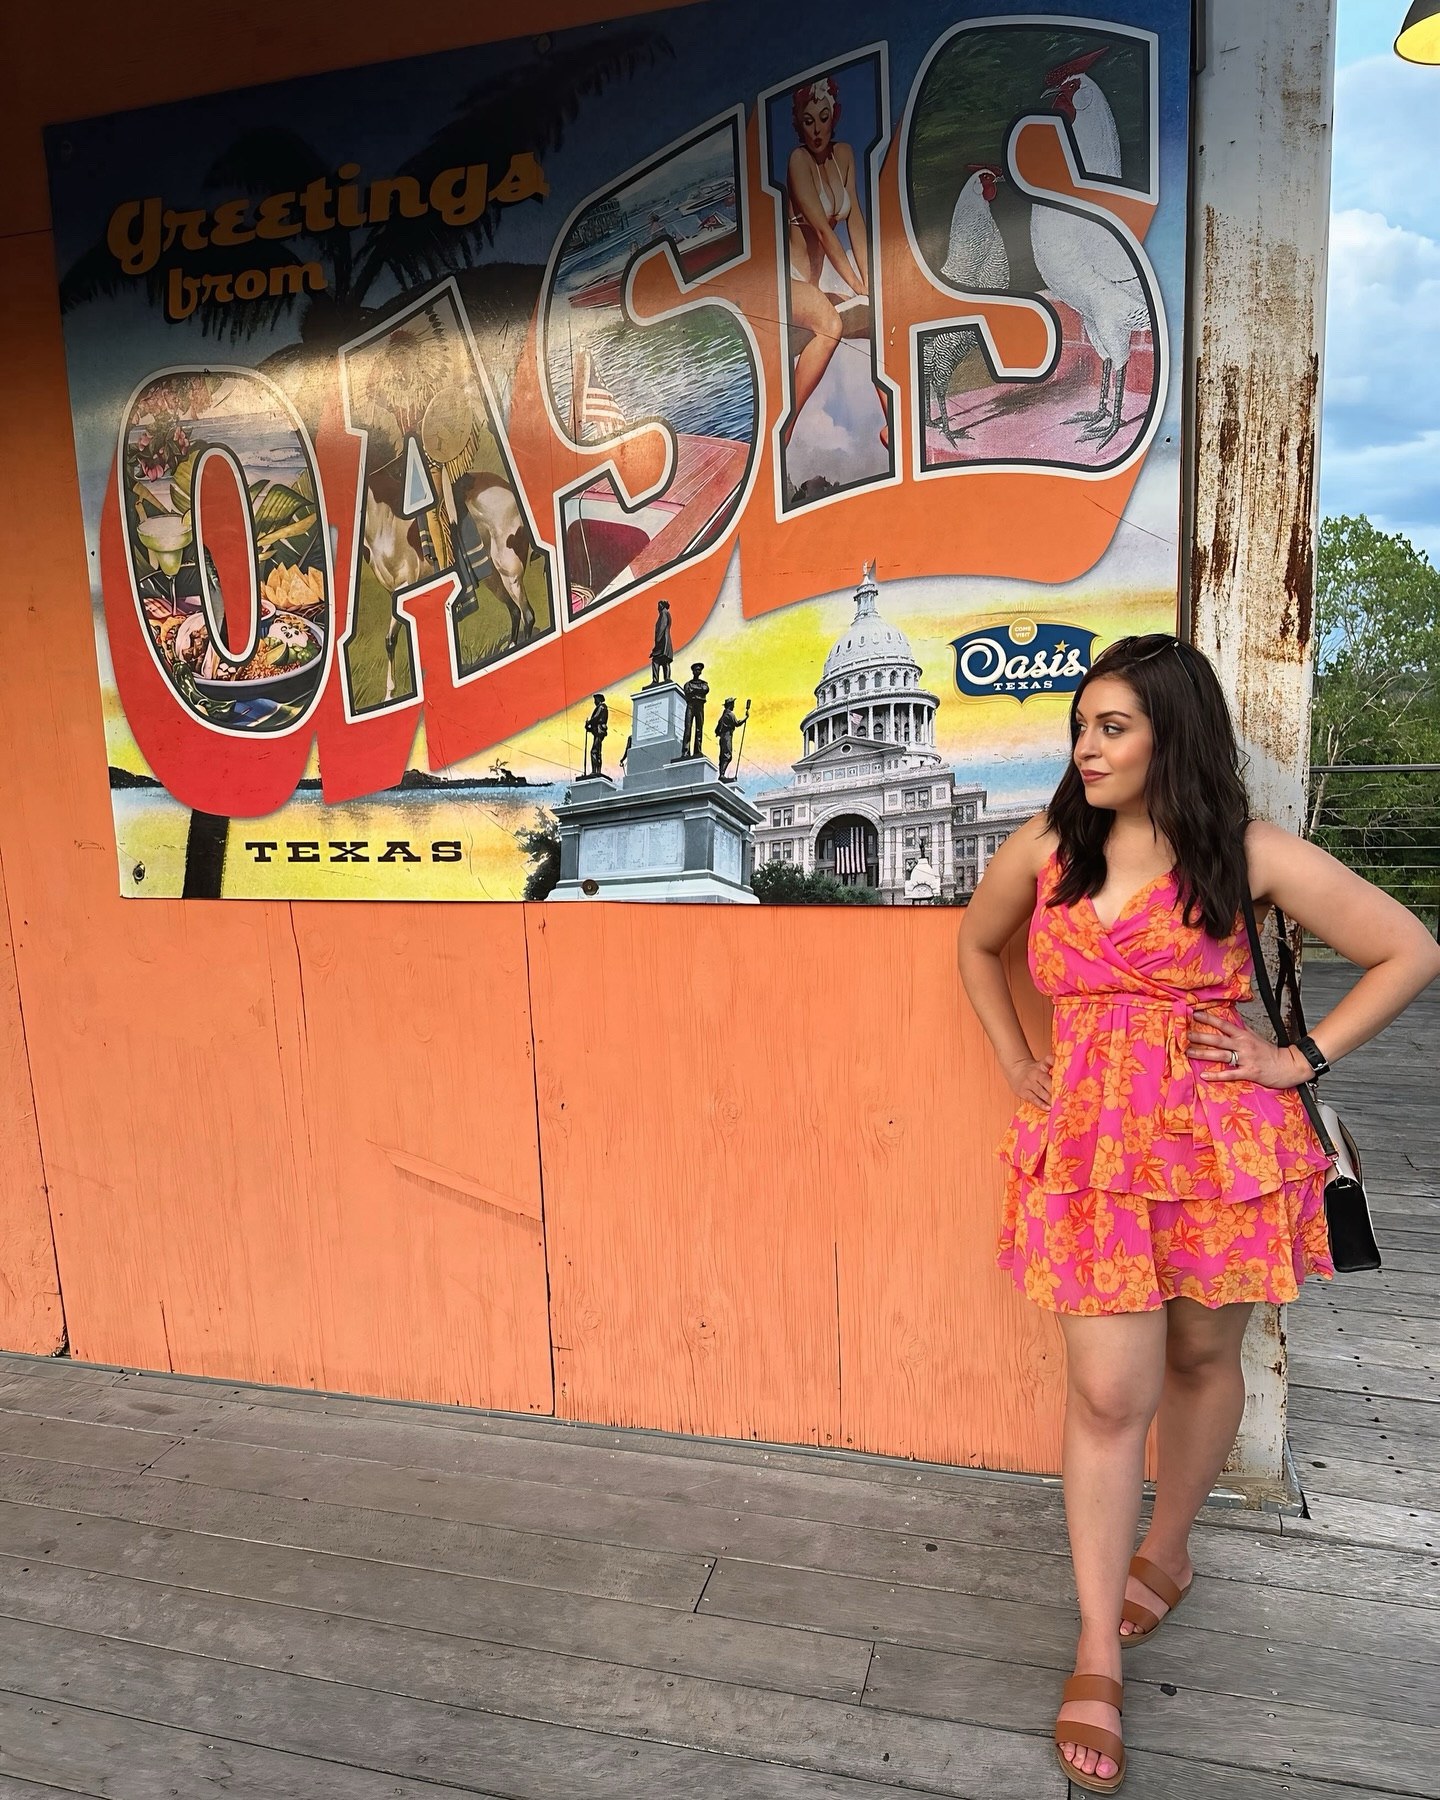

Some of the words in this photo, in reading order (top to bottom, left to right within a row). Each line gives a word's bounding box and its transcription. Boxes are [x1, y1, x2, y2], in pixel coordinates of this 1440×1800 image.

[119, 15, 1170, 739] OASIS
[960, 638, 1088, 686] Oasis
[993, 680, 1053, 691] TEXAS
[245, 841, 462, 863] TEXAS
